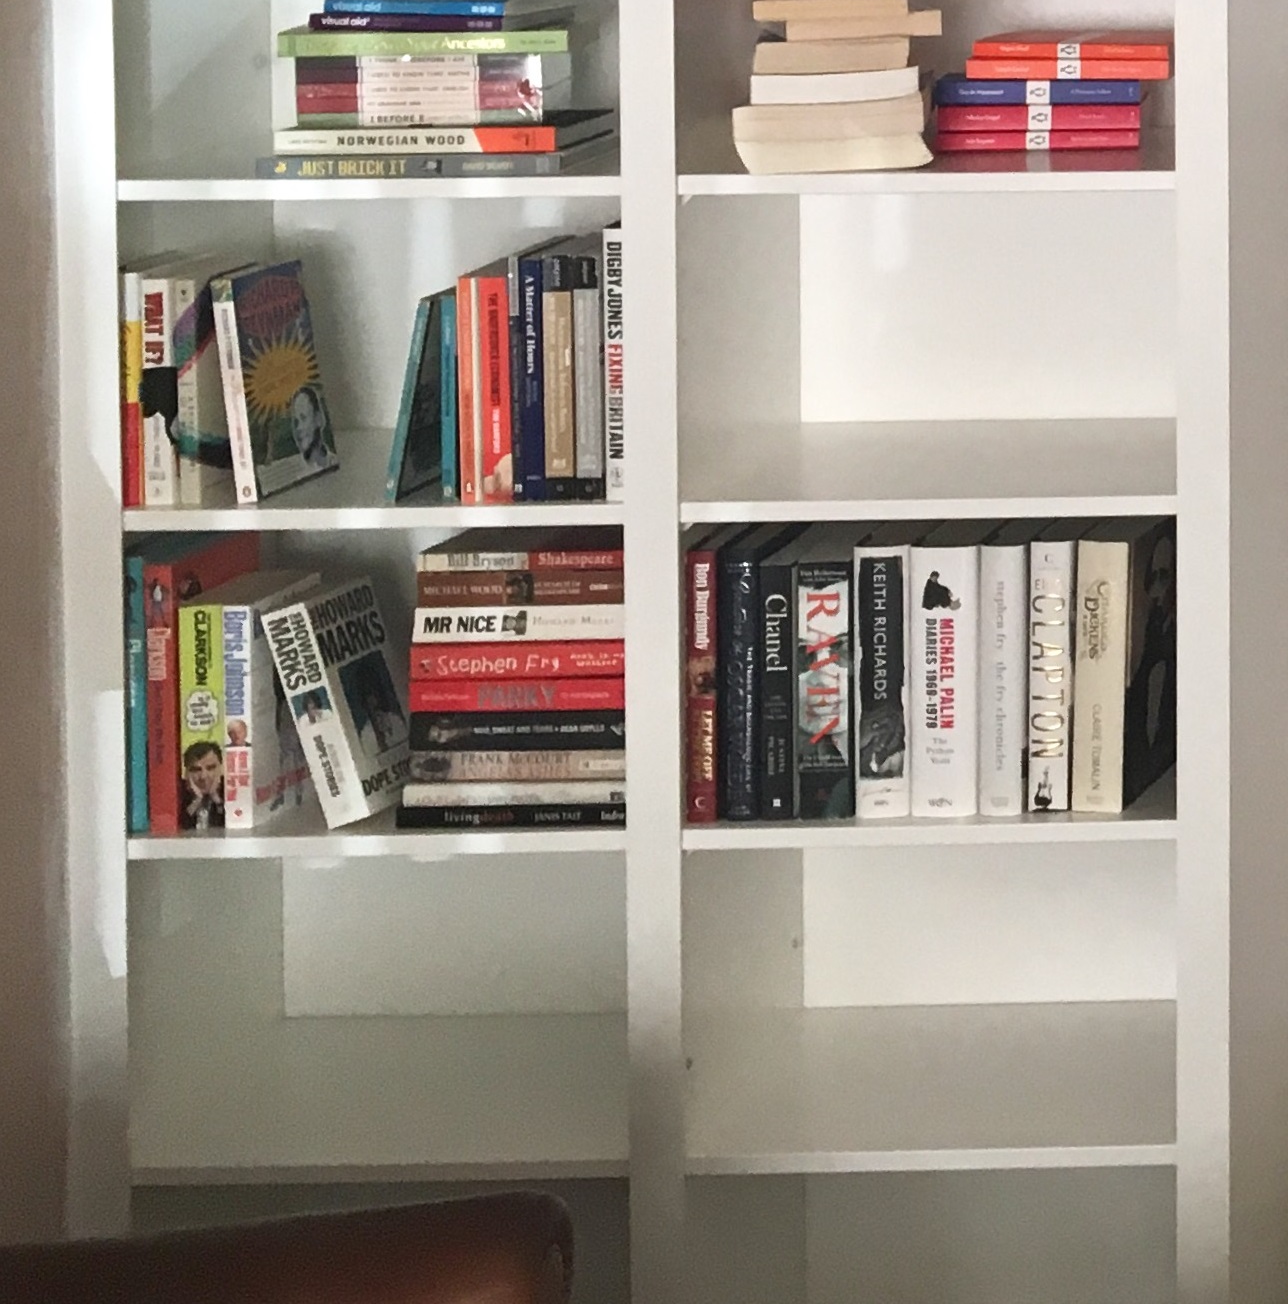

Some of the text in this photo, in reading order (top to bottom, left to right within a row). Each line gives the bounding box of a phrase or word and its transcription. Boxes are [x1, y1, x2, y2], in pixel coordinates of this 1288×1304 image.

[297, 159, 406, 175] JUST BRICK IT
[337, 136, 417, 146] NORWEGIAN
[425, 135, 465, 145] WOOD
[525, 275, 536, 374] A Matter of Hours
[607, 242, 623, 340] DIGBY JONES
[145, 292, 163, 365] WHAT IF?
[608, 344, 623, 459] FIXING BRITAIN
[448, 554, 514, 567] Bill Bryson
[538, 553, 614, 565] Shakespeare
[423, 616, 496, 633] MR NICE
[693, 563, 710, 650] Ron Burgundy
[765, 594, 787, 673] Chanel
[872, 562, 887, 700] KEITH RICHARDS
[195, 610, 208, 686] CLARKSON
[224, 610, 247, 716] Boris Johnson
[268, 616, 307, 690] MARKS
[294, 621, 322, 683] HOWARD
[437, 654, 560, 675] Stephen Fry
[926, 618, 937, 665] DIARIES
[939, 618, 954, 729] MICHAEL PALIN
[996, 662, 1006, 679] the
[1030, 594, 1065, 759] CLAPTON
[313, 735, 340, 797] DOPE STORIES
[995, 708, 1006, 771] chronicles
[361, 772, 390, 797] DOPE
